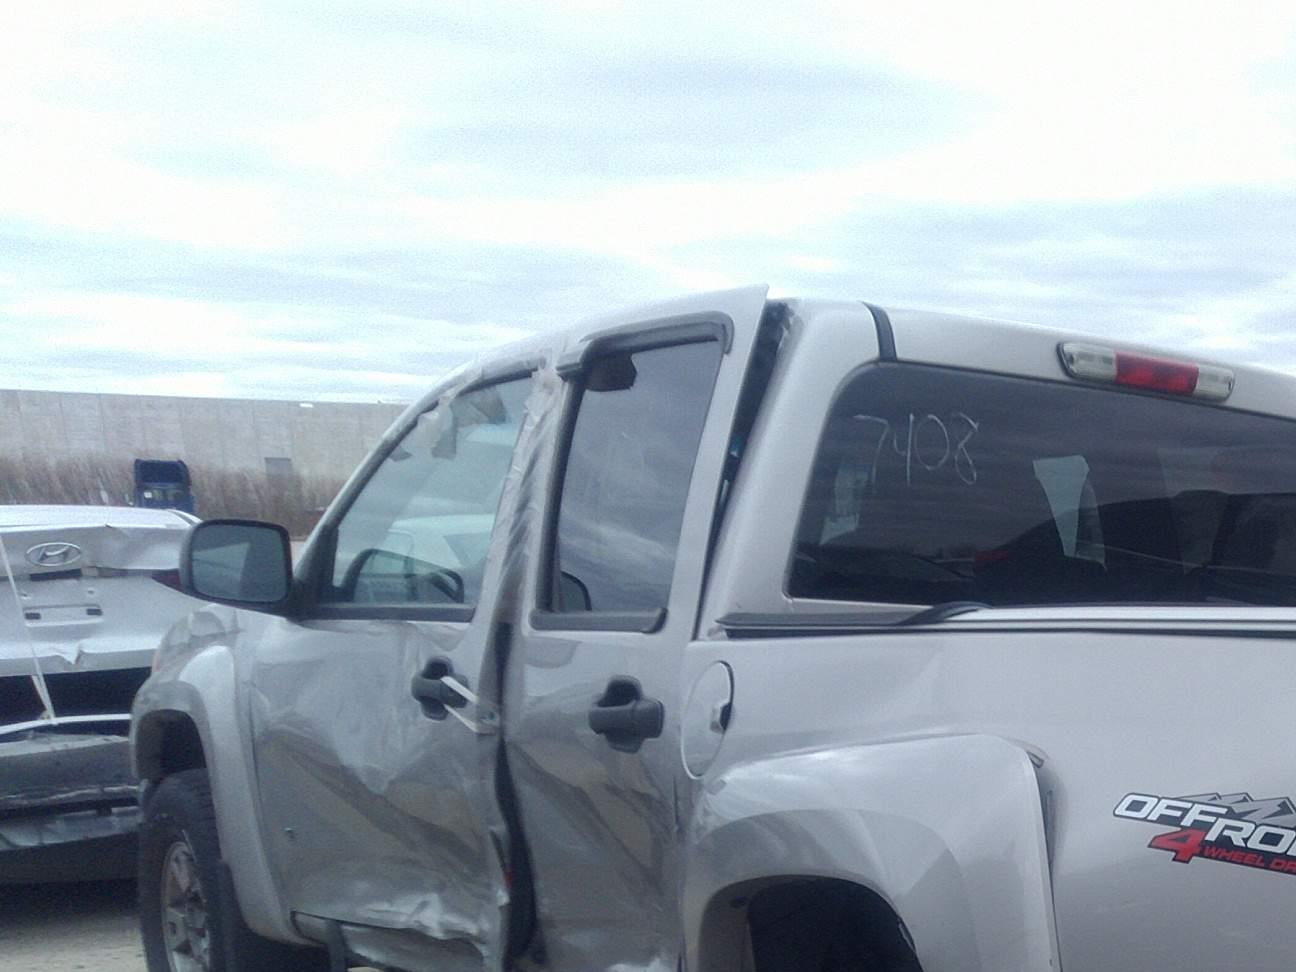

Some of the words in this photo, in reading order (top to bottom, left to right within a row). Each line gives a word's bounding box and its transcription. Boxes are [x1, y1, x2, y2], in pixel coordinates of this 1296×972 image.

[853, 412, 980, 490] 7408
[1149, 829, 1207, 863] 4
[1203, 846, 1266, 868] WHEEL
